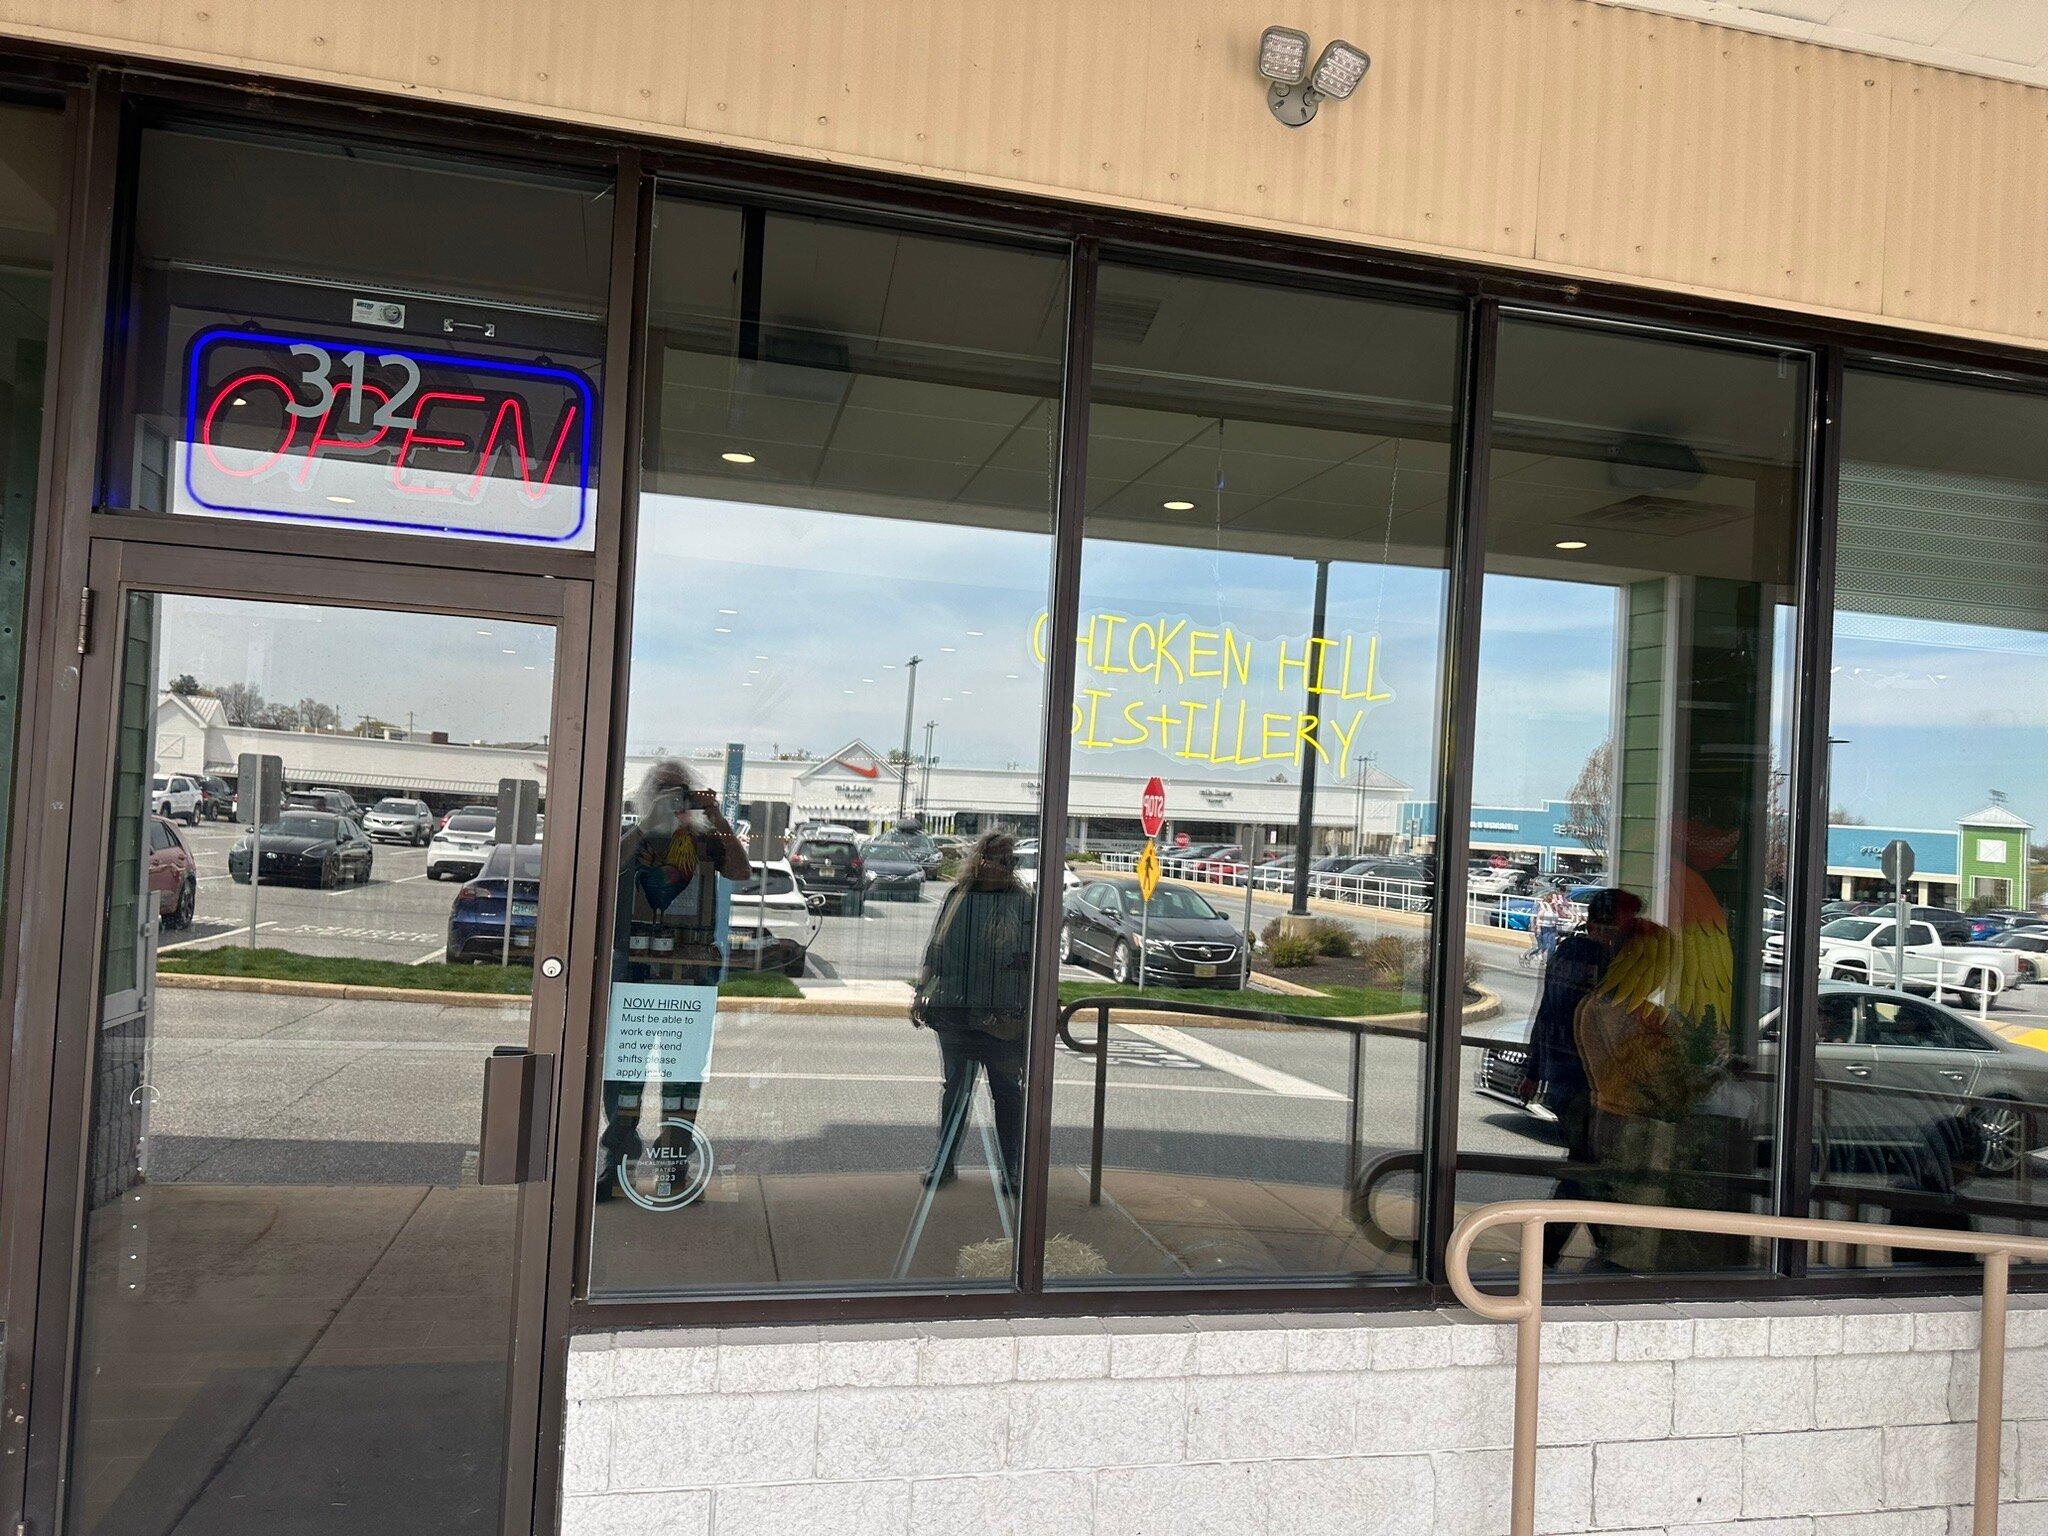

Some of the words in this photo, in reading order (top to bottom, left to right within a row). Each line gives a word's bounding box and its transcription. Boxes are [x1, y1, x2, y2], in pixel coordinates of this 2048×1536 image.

[285, 343, 421, 429] 312
[202, 373, 577, 500] OPEN
[1033, 612, 1252, 690] CHICKEN
[1277, 634, 1393, 702] HILL
[623, 998, 655, 1008] NOW
[658, 1000, 702, 1010] HIRING
[621, 1013, 645, 1023] Must
[648, 1015, 659, 1023] be
[662, 1015, 682, 1024] able
[685, 1016, 694, 1024] to
[620, 1028, 643, 1036] work
[645, 1030, 683, 1039] evening
[618, 1041, 636, 1049] and
[639, 1042, 682, 1051] weekend
[617, 1054, 643, 1064] shifts
[616, 1068, 642, 1078] apply
[646, 1147, 687, 1159] WELL
